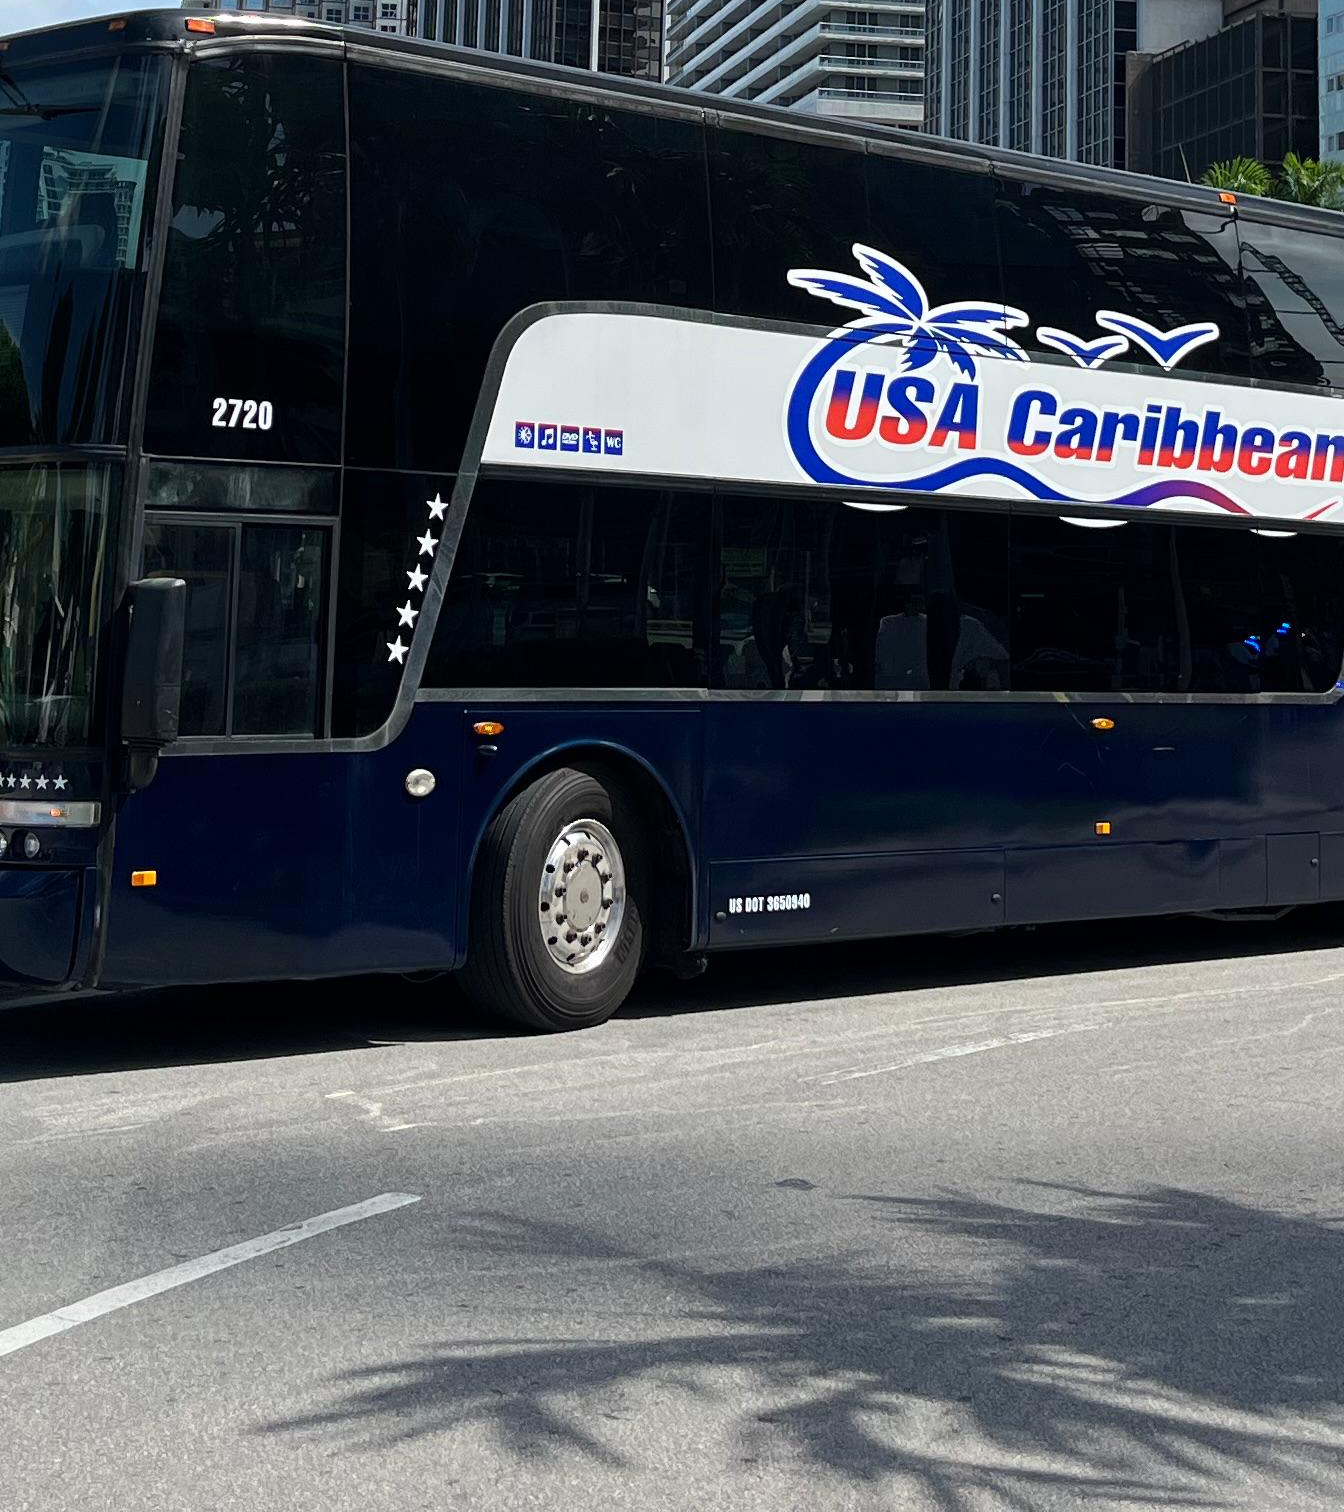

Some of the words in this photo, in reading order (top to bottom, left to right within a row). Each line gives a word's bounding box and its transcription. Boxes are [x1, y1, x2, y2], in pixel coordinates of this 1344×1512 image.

[211, 397, 274, 431] 2720
[823, 367, 980, 453] USA
[605, 436, 622, 449] WC
[729, 897, 743, 914] US
[745, 896, 765, 913] DOT
